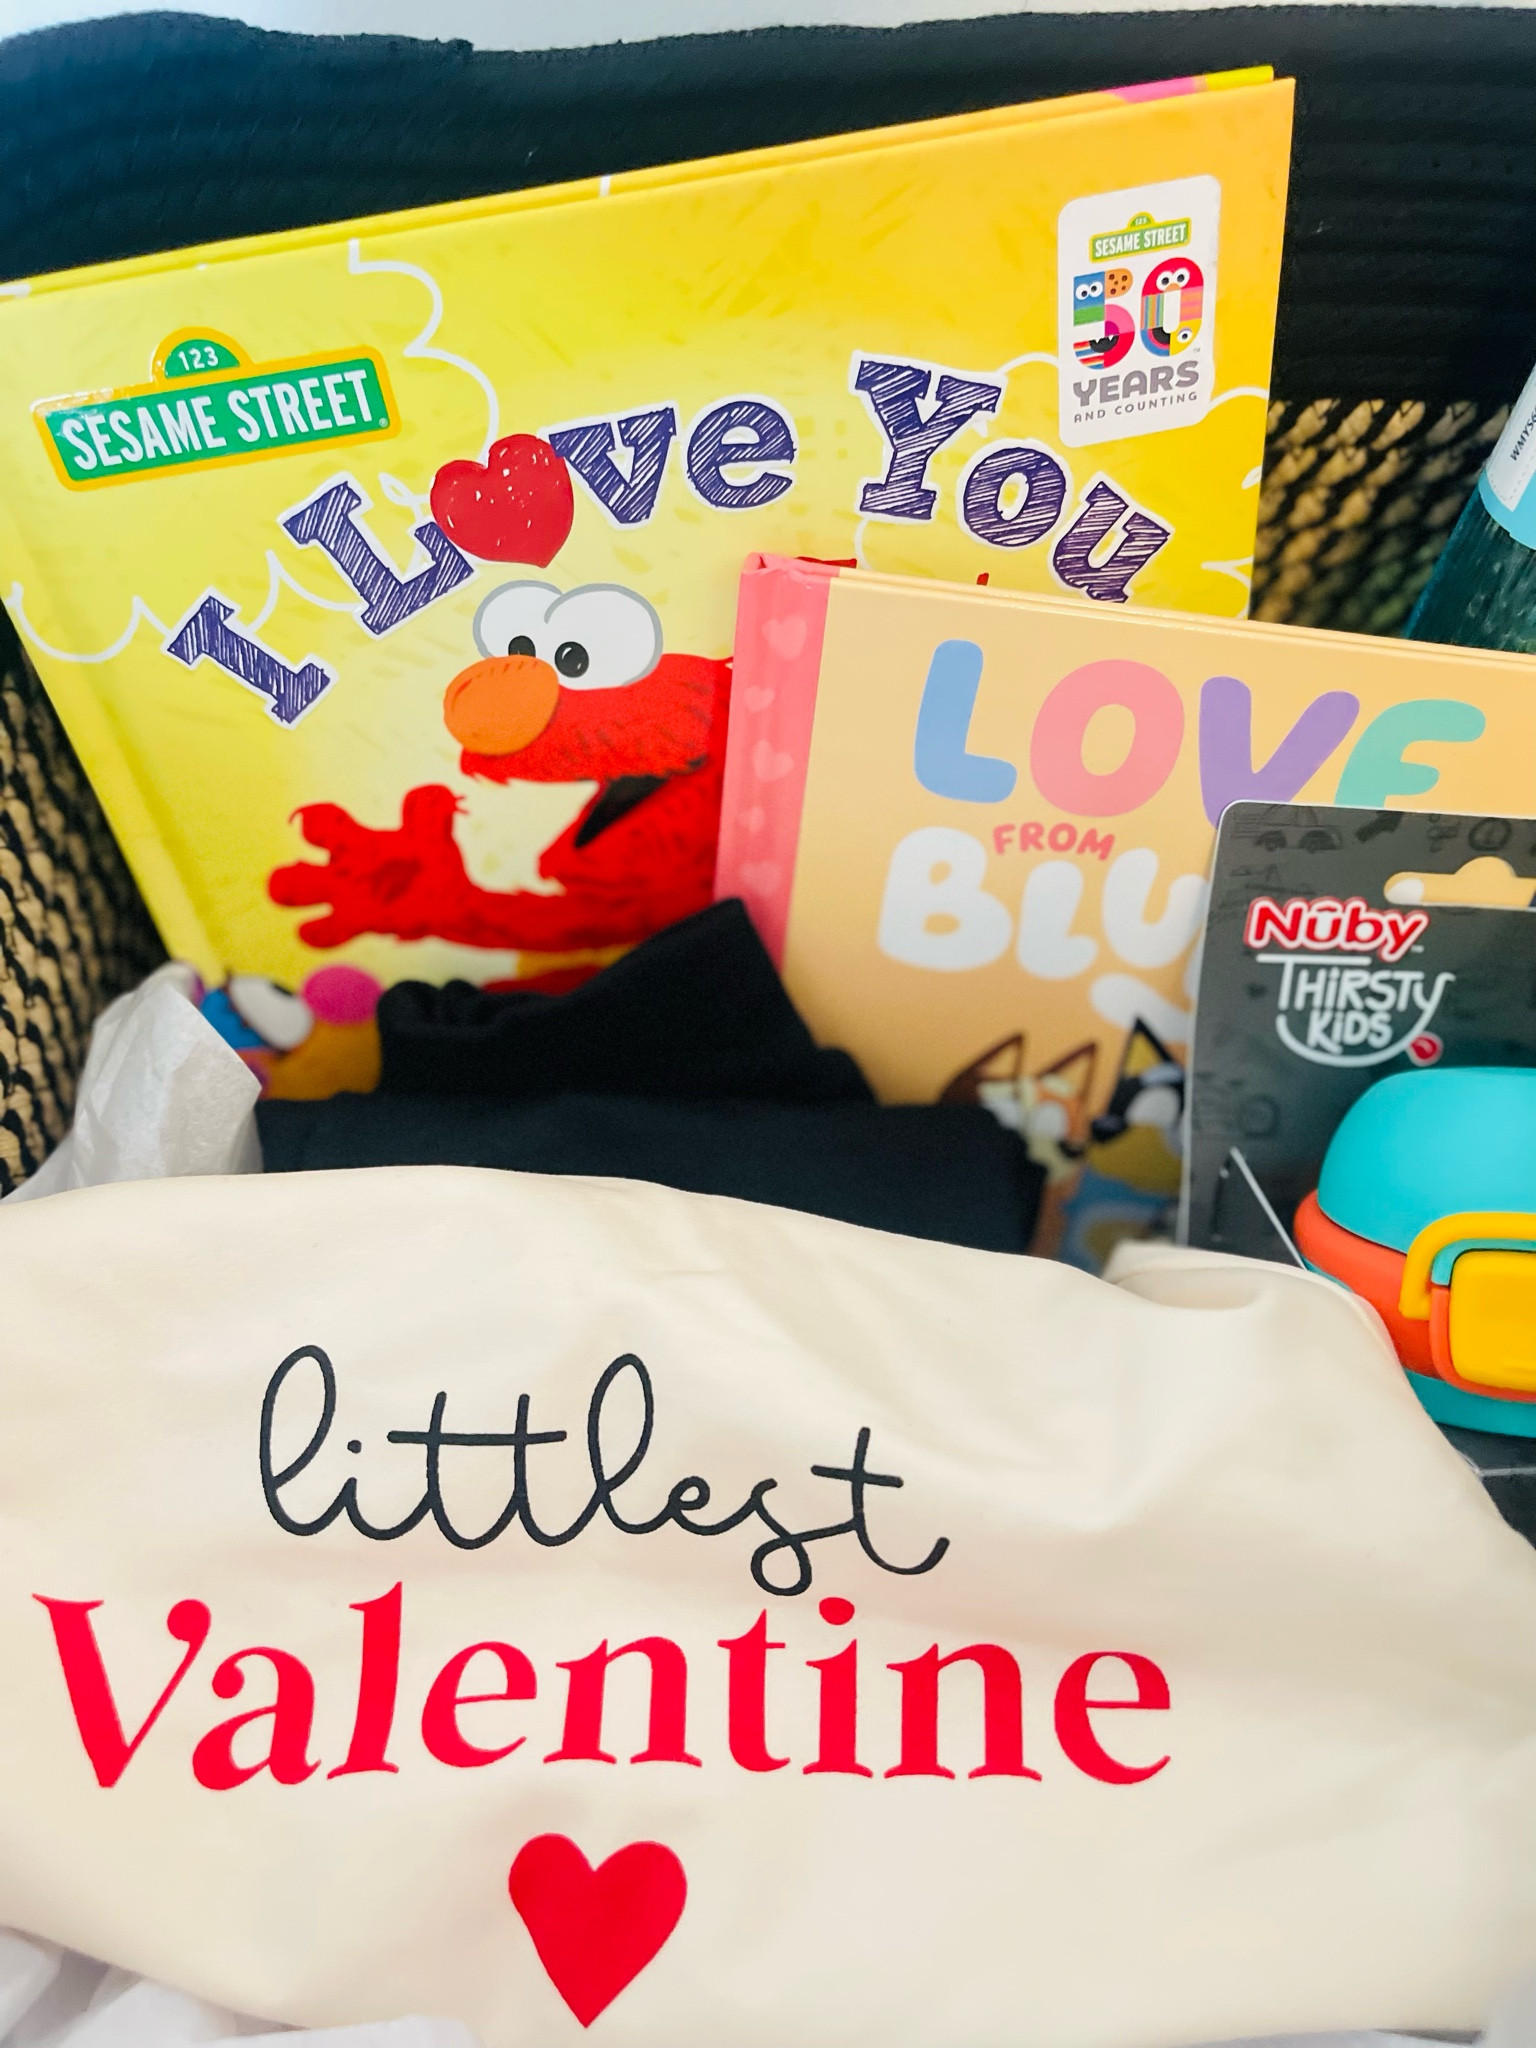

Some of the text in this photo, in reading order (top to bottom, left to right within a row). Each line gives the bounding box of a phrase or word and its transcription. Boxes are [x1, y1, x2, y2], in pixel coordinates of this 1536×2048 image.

[1095, 223, 1186, 258] SESAME STREET
[177, 345, 219, 372] 123
[1073, 257, 1204, 370] 50
[62, 369, 374, 471] SESAME STREET
[1073, 360, 1199, 407] YEARS
[1074, 391, 1197, 423] AND COUNTING
[166, 594, 332, 726] I
[854, 358, 1172, 604] You
[914, 639, 1487, 829] LOVE
[993, 822, 1115, 861] FROM
[878, 826, 1209, 981] BLU
[258, 1345, 950, 1596] littlest
[31, 1581, 1173, 1791] Valentine
